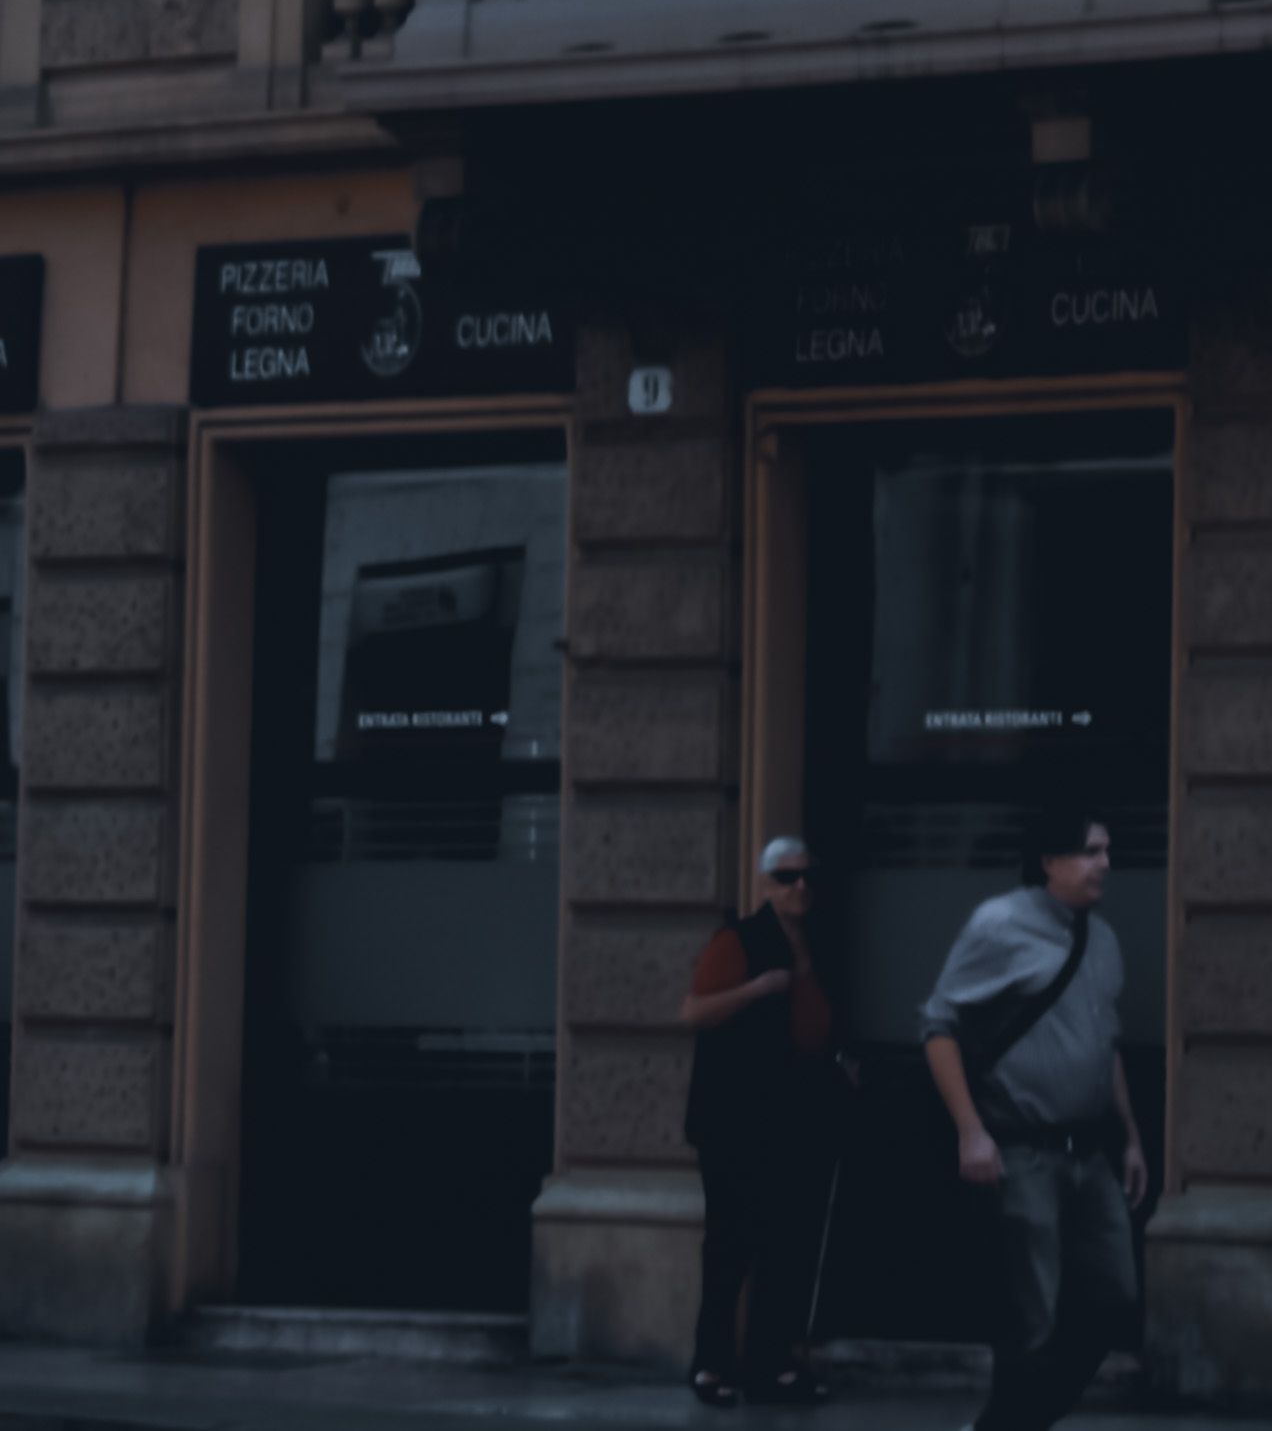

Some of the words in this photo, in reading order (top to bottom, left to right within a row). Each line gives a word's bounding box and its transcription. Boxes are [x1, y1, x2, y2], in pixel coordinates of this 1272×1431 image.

[220, 257, 329, 294] PIZZERIA
[231, 303, 314, 336] FORNO
[1051, 287, 1159, 327] CUCINA
[456, 311, 553, 348] CUCINA
[796, 326, 884, 362] LEGNA
[230, 345, 311, 382] LEGNA
[643, 371, 660, 407] 9
